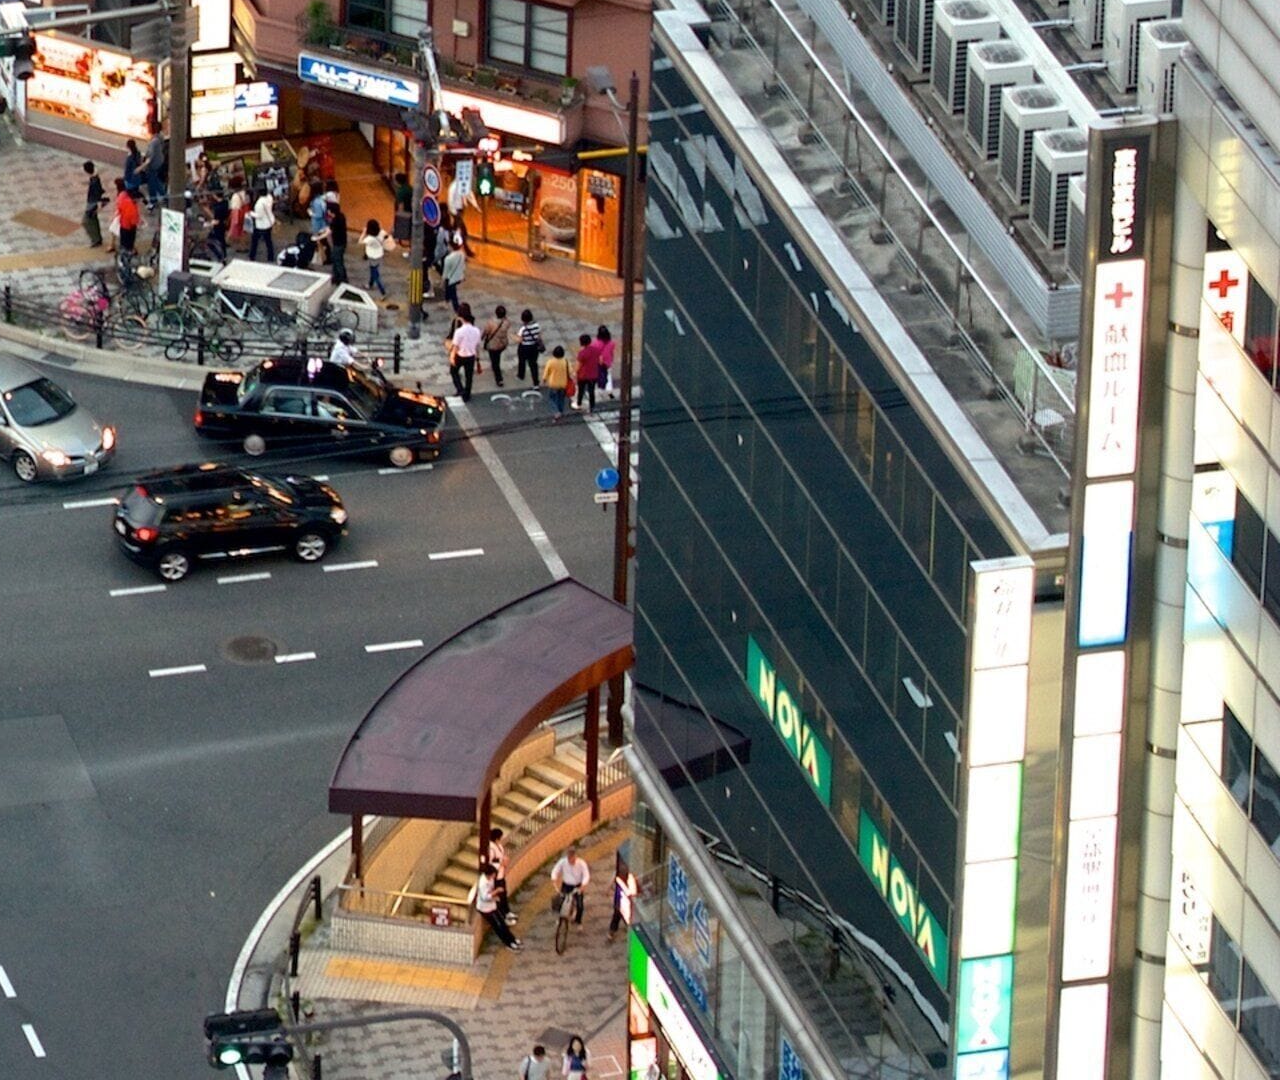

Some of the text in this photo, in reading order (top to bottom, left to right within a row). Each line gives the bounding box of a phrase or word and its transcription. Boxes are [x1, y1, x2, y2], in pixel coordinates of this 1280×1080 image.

[550, 174, 576, 193] 250
[1102, 324, 1129, 451] 献血ルーム
[760, 657, 820, 789] NOVA
[872, 832, 937, 969] NOVA
[968, 960, 1002, 1049] NOVA
